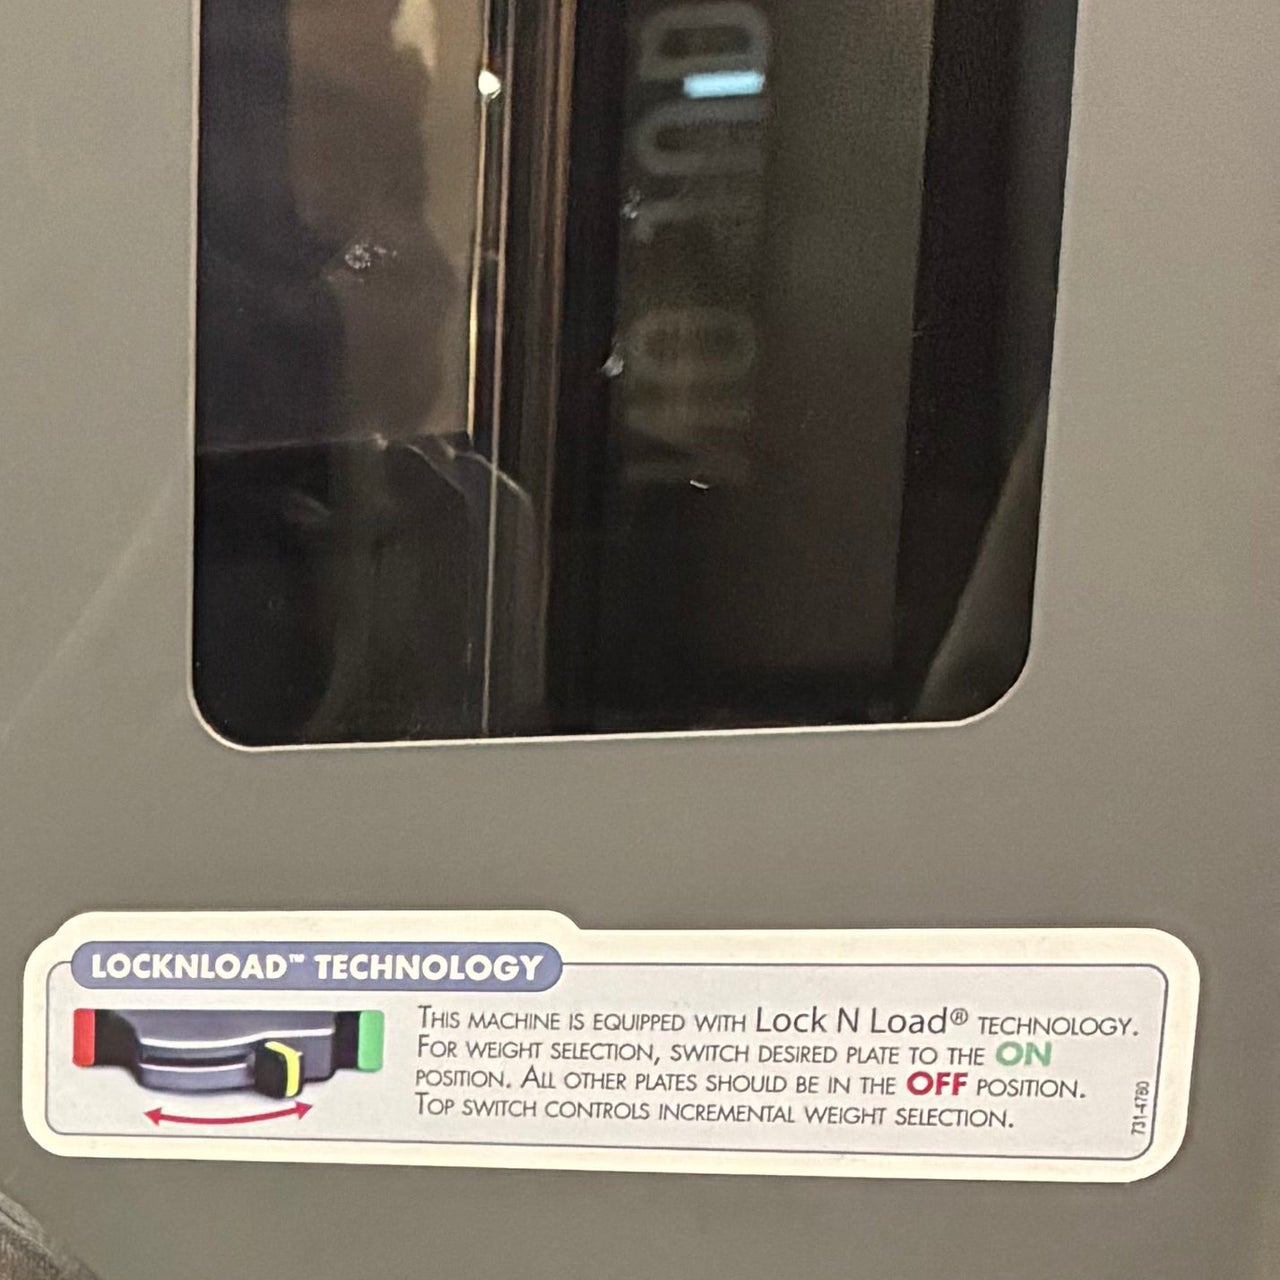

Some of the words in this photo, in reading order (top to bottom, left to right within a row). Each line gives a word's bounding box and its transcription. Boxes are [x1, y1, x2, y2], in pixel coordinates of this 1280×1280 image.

[315, 953, 543, 982] TECHNOLOGY
[417, 1004, 460, 1029] THIS
[468, 1012, 560, 1031] MACHINE
[569, 1013, 585, 1031] IS
[593, 1013, 686, 1032] EQUIPPED
[694, 1014, 746, 1032] WITH
[756, 1005, 827, 1033] Lock
[837, 1007, 860, 1033] N
[978, 1016, 1139, 1037] TECHNOLOGY.
[418, 1034, 457, 1058] FOR
[466, 1041, 543, 1059] WEIGHT
[550, 1042, 660, 1066] SELECTION,
[670, 1044, 750, 1063] SWITCH
[758, 1045, 838, 1064] DESIRED
[846, 1046, 899, 1065] PLATE
[909, 1046, 938, 1065] TO
[947, 1047, 985, 1066] THE
[995, 1041, 1052, 1067] ON
[416, 1069, 511, 1088] POSITION.
[520, 1064, 556, 1089] ALL
[563, 1071, 627, 1090] OTHER
[635, 1073, 697, 1092] PLATES
[705, 1074, 788, 1093] SHOULD
[796, 1075, 819, 1094] BE
[828, 1076, 851, 1094] IN
[859, 1076, 896, 1095] THE
[906, 1070, 969, 1096] OFF
[976, 1078, 1086, 1099] POSITION.
[414, 1091, 455, 1115] TOP
[462, 1099, 537, 1117] SWITCH
[544, 1100, 650, 1120] CONTROLS
[658, 1103, 795, 1124] INCREMENTAL
[804, 1106, 887, 1125] WEIGHT
[894, 1107, 1014, 1128] SELECTION.
